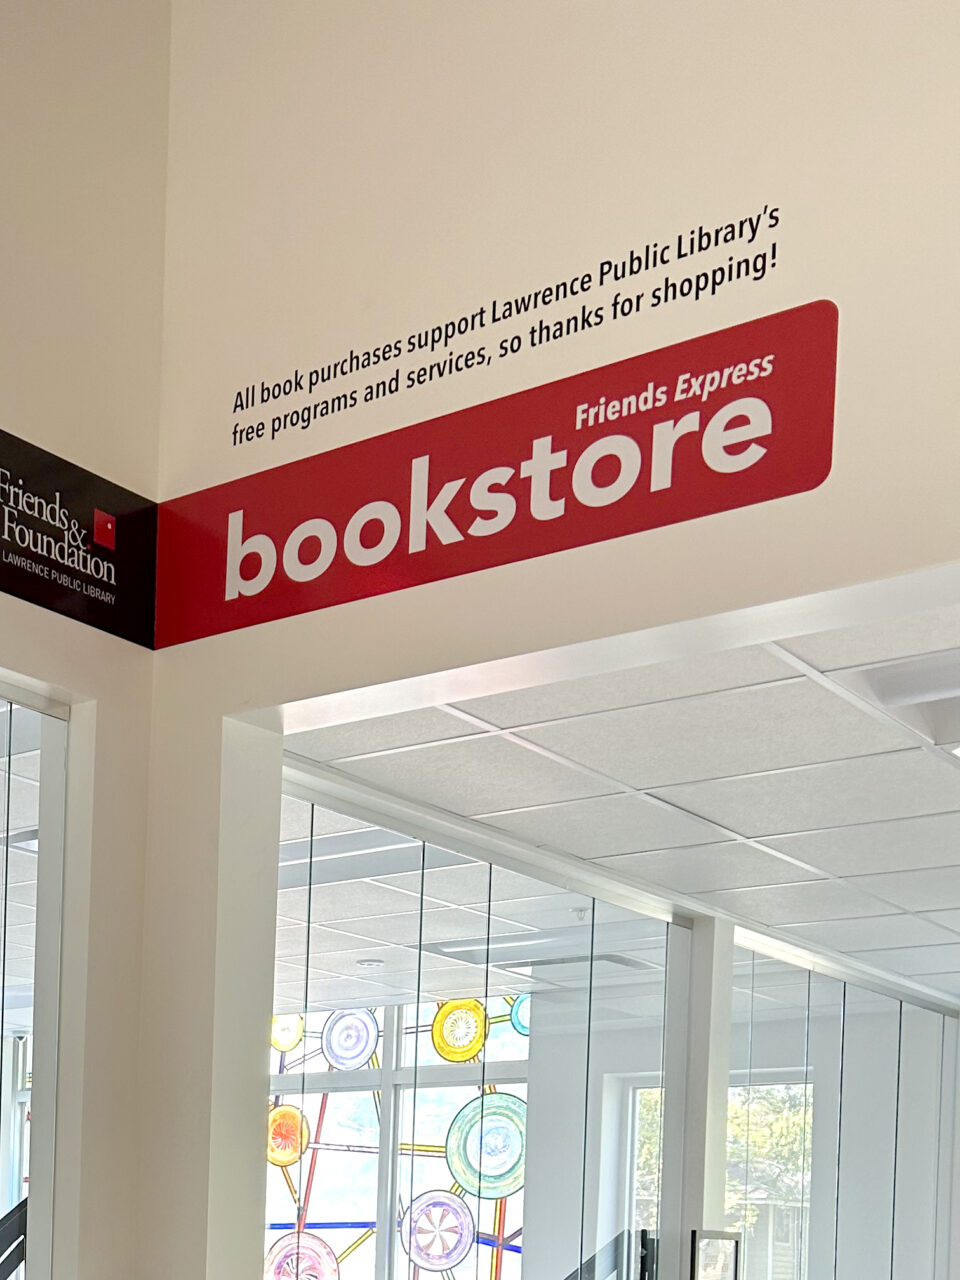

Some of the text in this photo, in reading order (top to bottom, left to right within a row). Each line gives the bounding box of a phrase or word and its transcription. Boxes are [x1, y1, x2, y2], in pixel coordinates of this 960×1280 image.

[231, 242, 777, 446] free programs and services, so thanks for shopping!
[233, 204, 780, 413] All book purchases support Lawrence Public Library's
[575, 354, 775, 431] Friends Express
[68, 519, 87, 550] &
[225, 396, 773, 601] bookstore
[1, 504, 116, 585] Foundation
[2, 549, 116, 605] LAWRENCE PUBLIC LIBRARY
